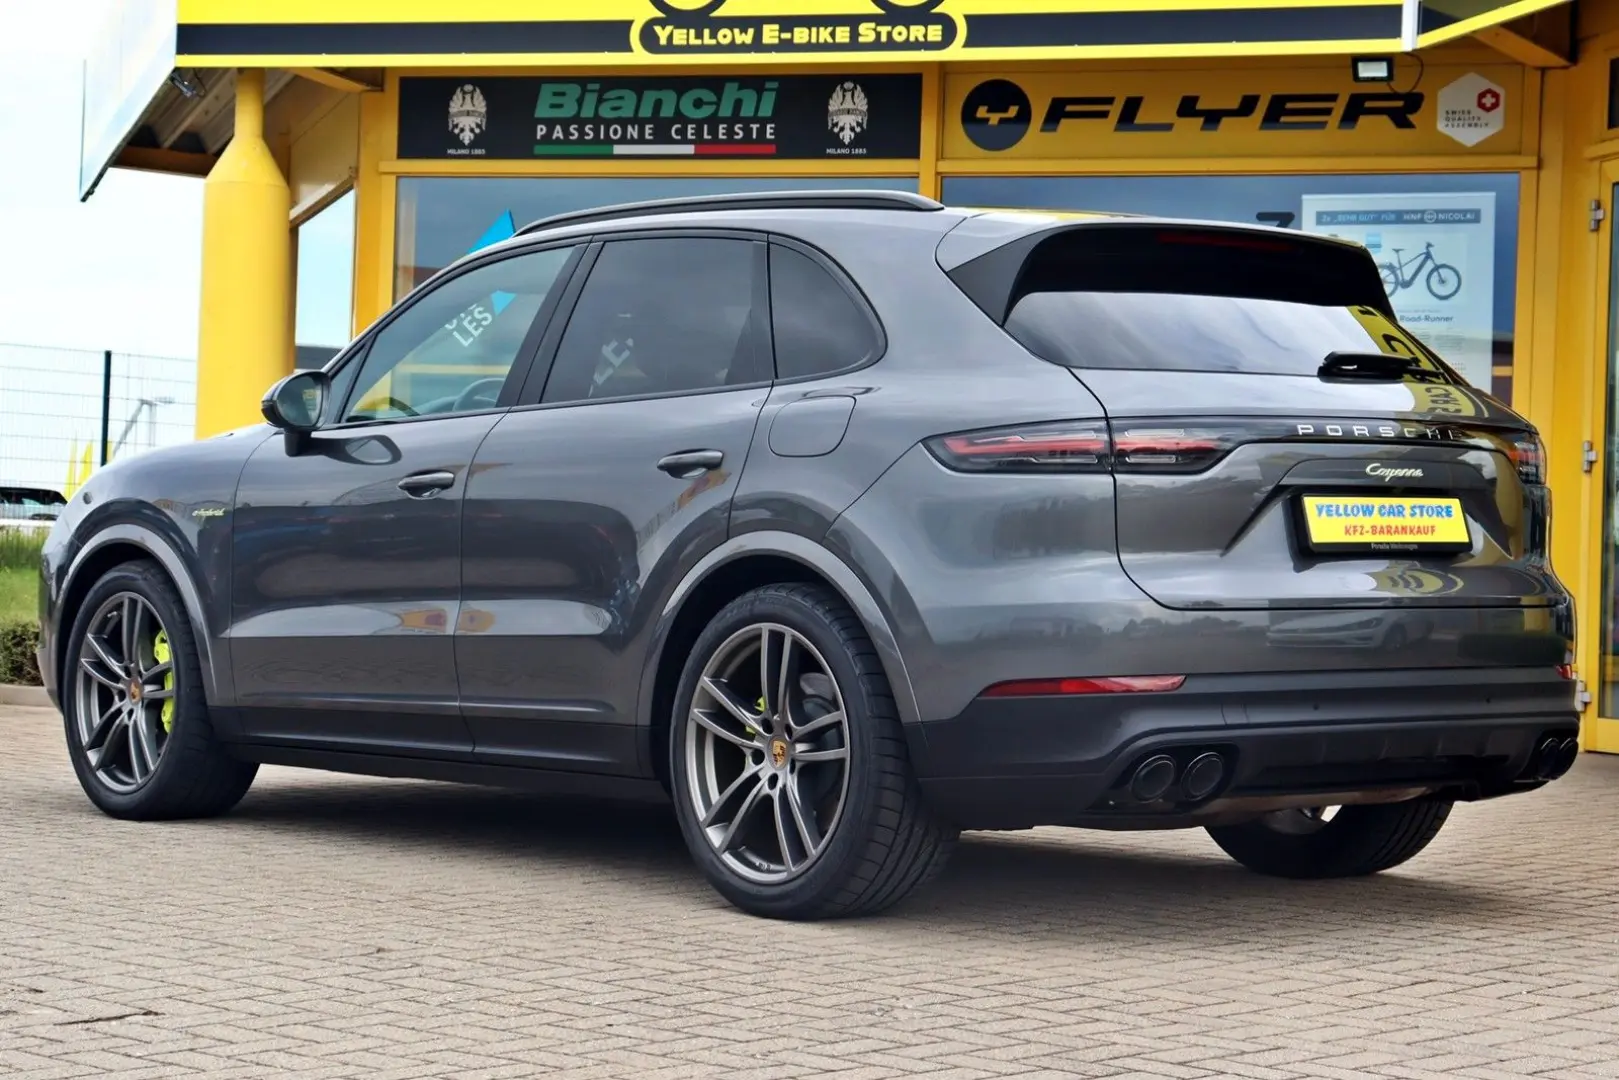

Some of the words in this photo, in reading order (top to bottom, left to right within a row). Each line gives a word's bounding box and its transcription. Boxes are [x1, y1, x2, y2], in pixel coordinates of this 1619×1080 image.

[653, 25, 755, 45] YELLOW
[762, 23, 851, 44] E-BIKE
[857, 22, 942, 43] STORE
[534, 81, 779, 119] Bianchi
[1040, 92, 1425, 132] FLYER
[536, 124, 654, 140] PASSIONE
[671, 124, 776, 140] CELESTE
[1438, 212, 1475, 221] NICOLAI
[1297, 424, 1462, 440] PORSCHE
[1365, 462, 1424, 482] Cayenne
[1315, 504, 1375, 518] YELLOW
[1378, 504, 1406, 518] CAR
[1409, 504, 1453, 518] STORE
[1344, 524, 1437, 536] KFZ-BARANKAUF
